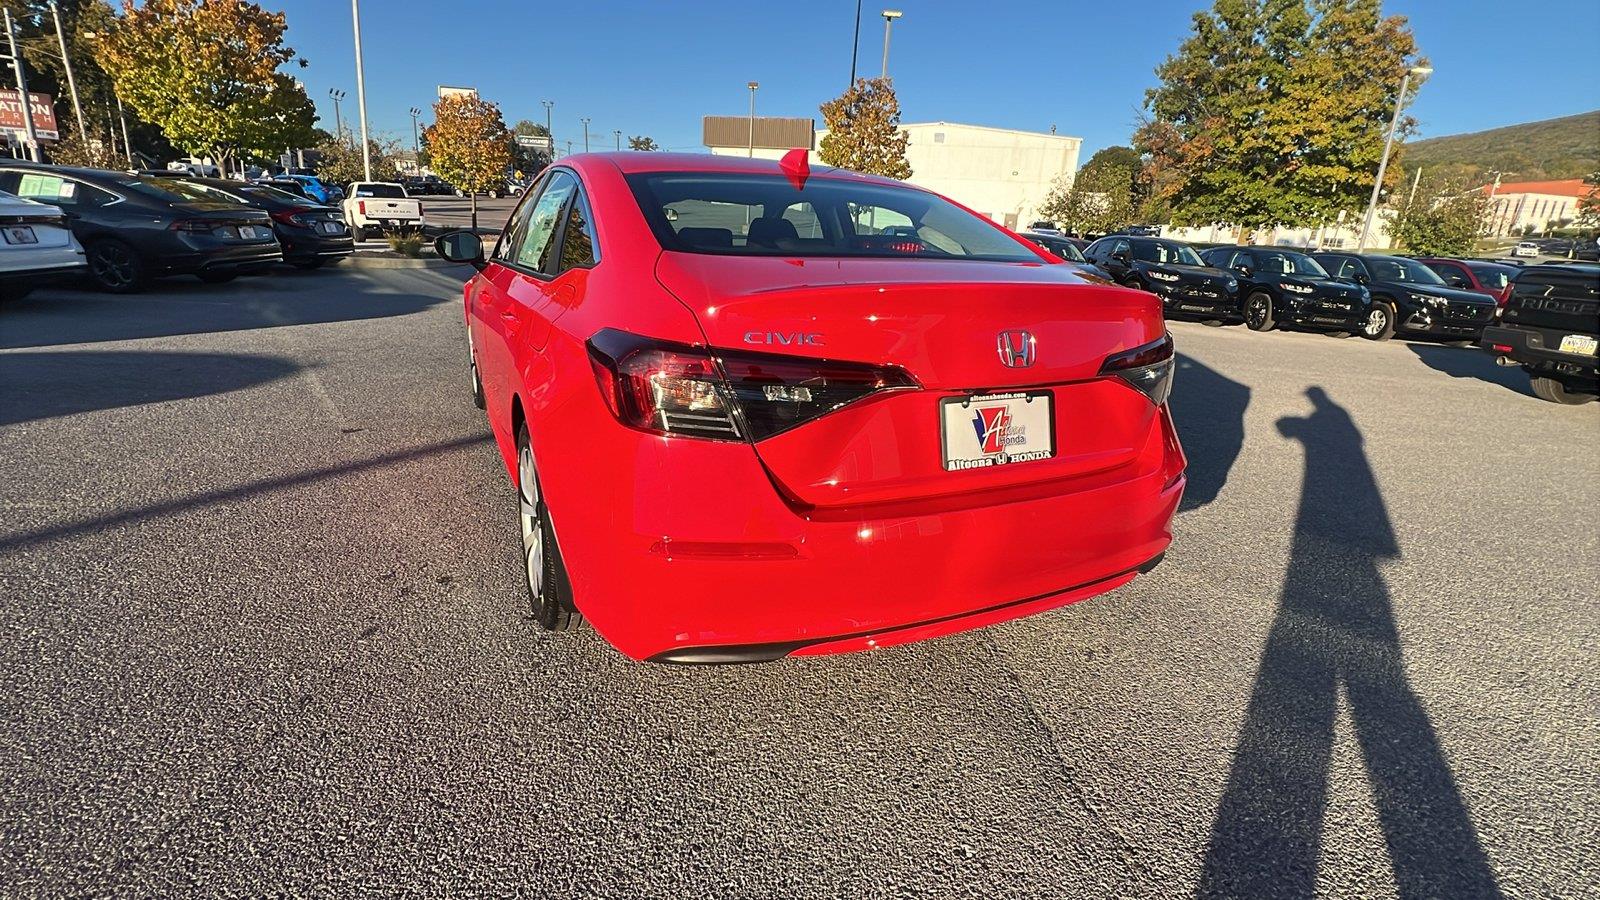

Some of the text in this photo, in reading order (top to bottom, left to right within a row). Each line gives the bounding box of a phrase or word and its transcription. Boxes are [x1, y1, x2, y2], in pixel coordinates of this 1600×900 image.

[743, 331, 826, 346] CIVIC
[970, 392, 1027, 402] altoonahonda.com
[999, 435, 1026, 445] Honda
[947, 457, 993, 471] Altoona
[1010, 450, 1052, 463] HONDA
